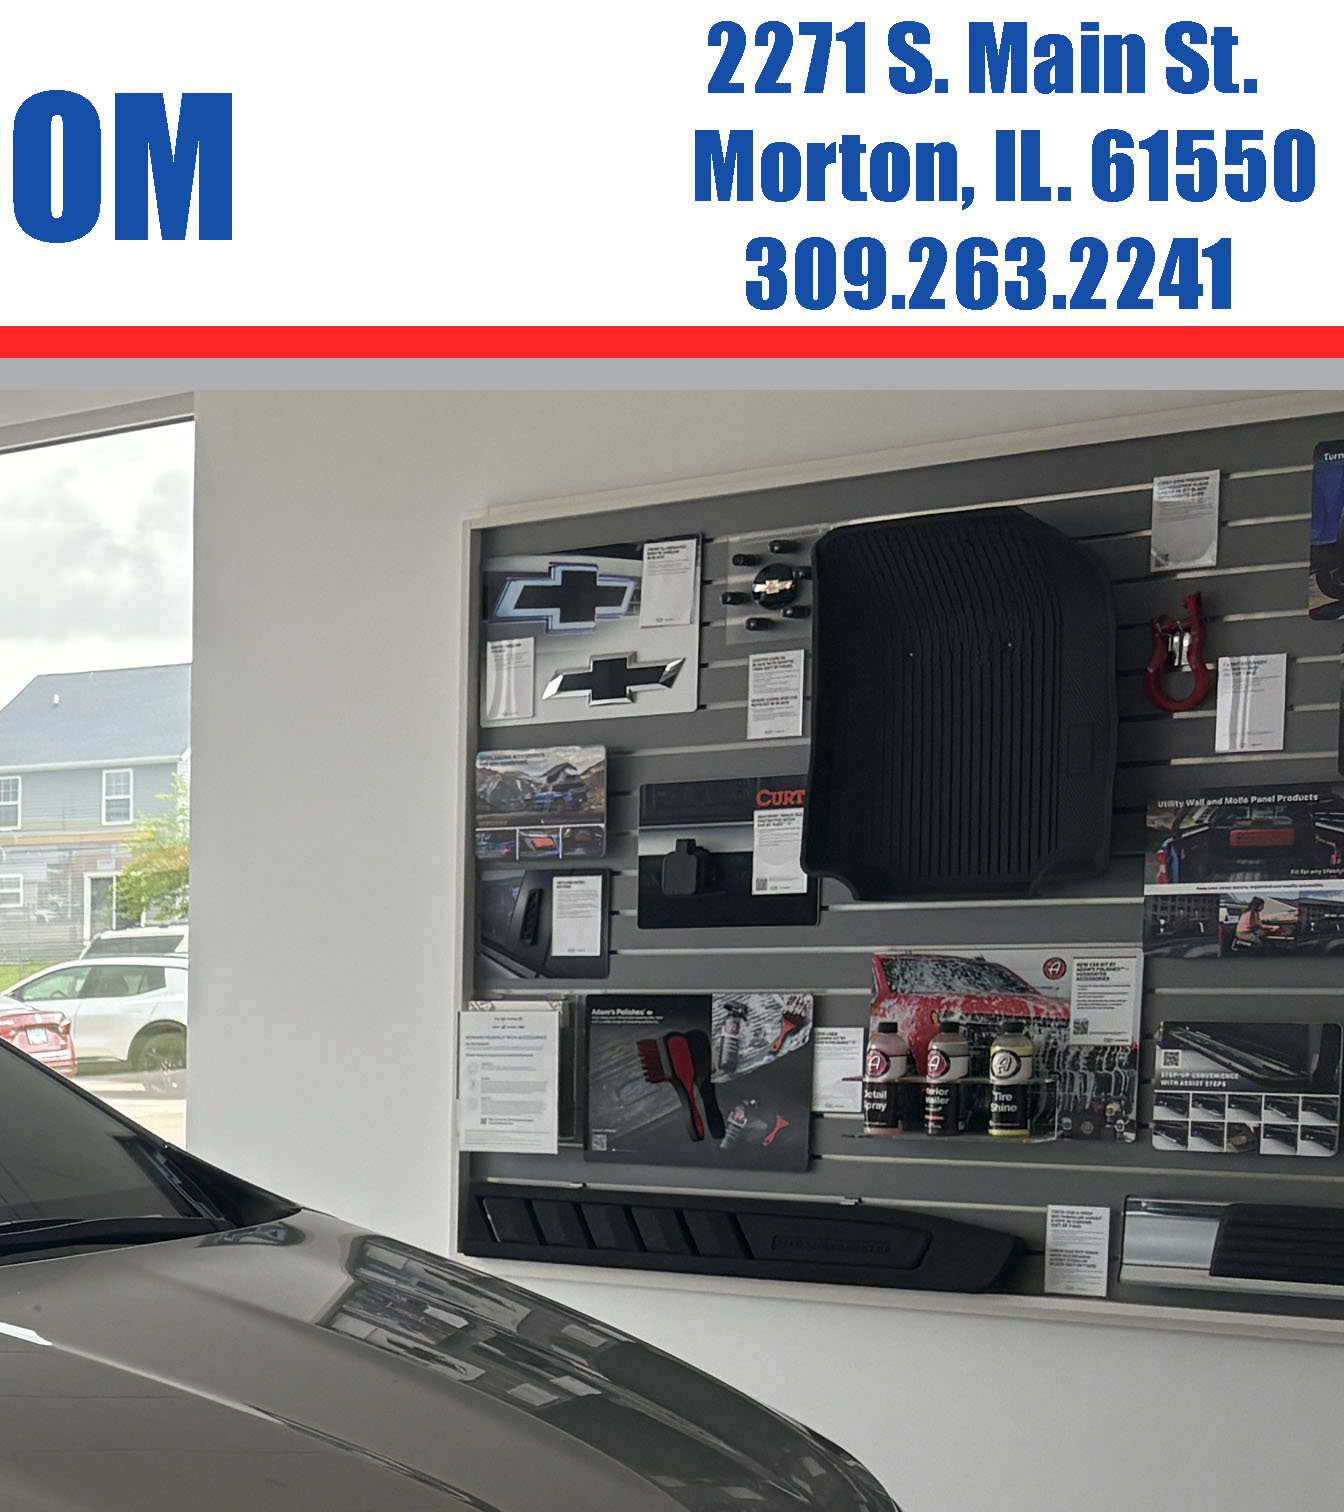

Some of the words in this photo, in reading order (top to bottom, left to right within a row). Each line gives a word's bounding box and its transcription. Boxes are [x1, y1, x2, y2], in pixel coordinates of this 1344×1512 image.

[755, 789, 807, 807] CURT
[1157, 800, 1184, 808] Utility
[1185, 798, 1205, 807] Wall
[1206, 798, 1223, 806] and
[1250, 795, 1275, 804] Panel
[1276, 793, 1319, 802] Products
[993, 1091, 1013, 1101] Tire
[990, 1103, 1018, 1112] Shine
